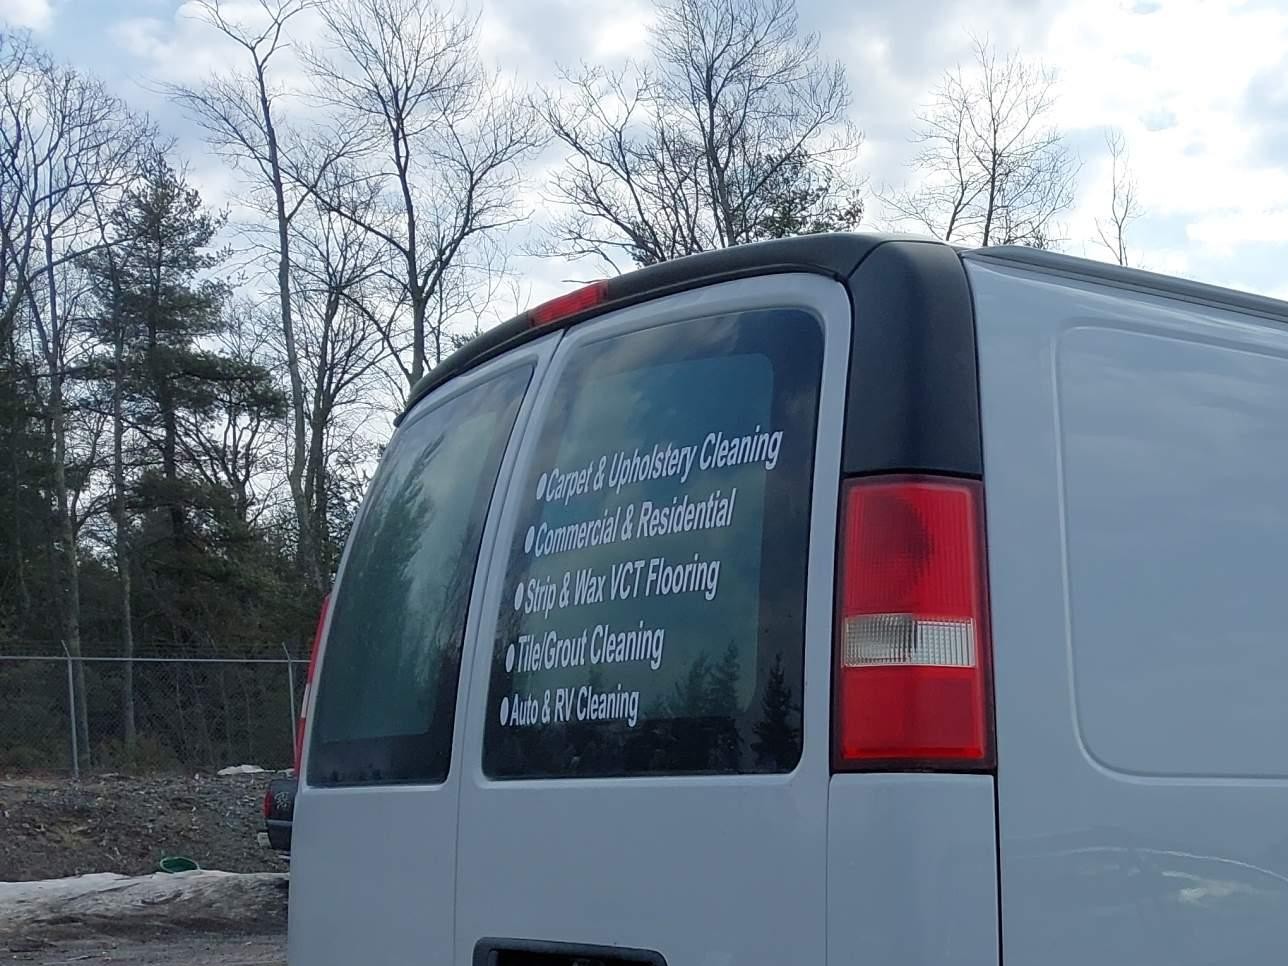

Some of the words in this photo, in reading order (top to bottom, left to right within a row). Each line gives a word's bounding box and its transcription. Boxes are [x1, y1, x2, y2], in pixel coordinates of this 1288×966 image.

[545, 460, 594, 505] Carpet
[593, 456, 606, 490] &
[608, 442, 697, 495] Upholstery
[700, 425, 783, 469] Cleaning
[535, 506, 619, 557] Commercial
[621, 504, 634, 541] &
[637, 488, 736, 538] Residential
[524, 571, 556, 619] Strip
[559, 572, 571, 608] &
[574, 571, 606, 606] Wax
[611, 560, 645, 602] VCT
[646, 553, 720, 601] Flooring
[517, 626, 589, 673] Tile/Grout
[590, 621, 664, 670] Cleaning
[510, 693, 538, 726] Auto
[541, 689, 551, 723] &
[553, 688, 575, 722] RV
[576, 684, 639, 728] Cleaning
